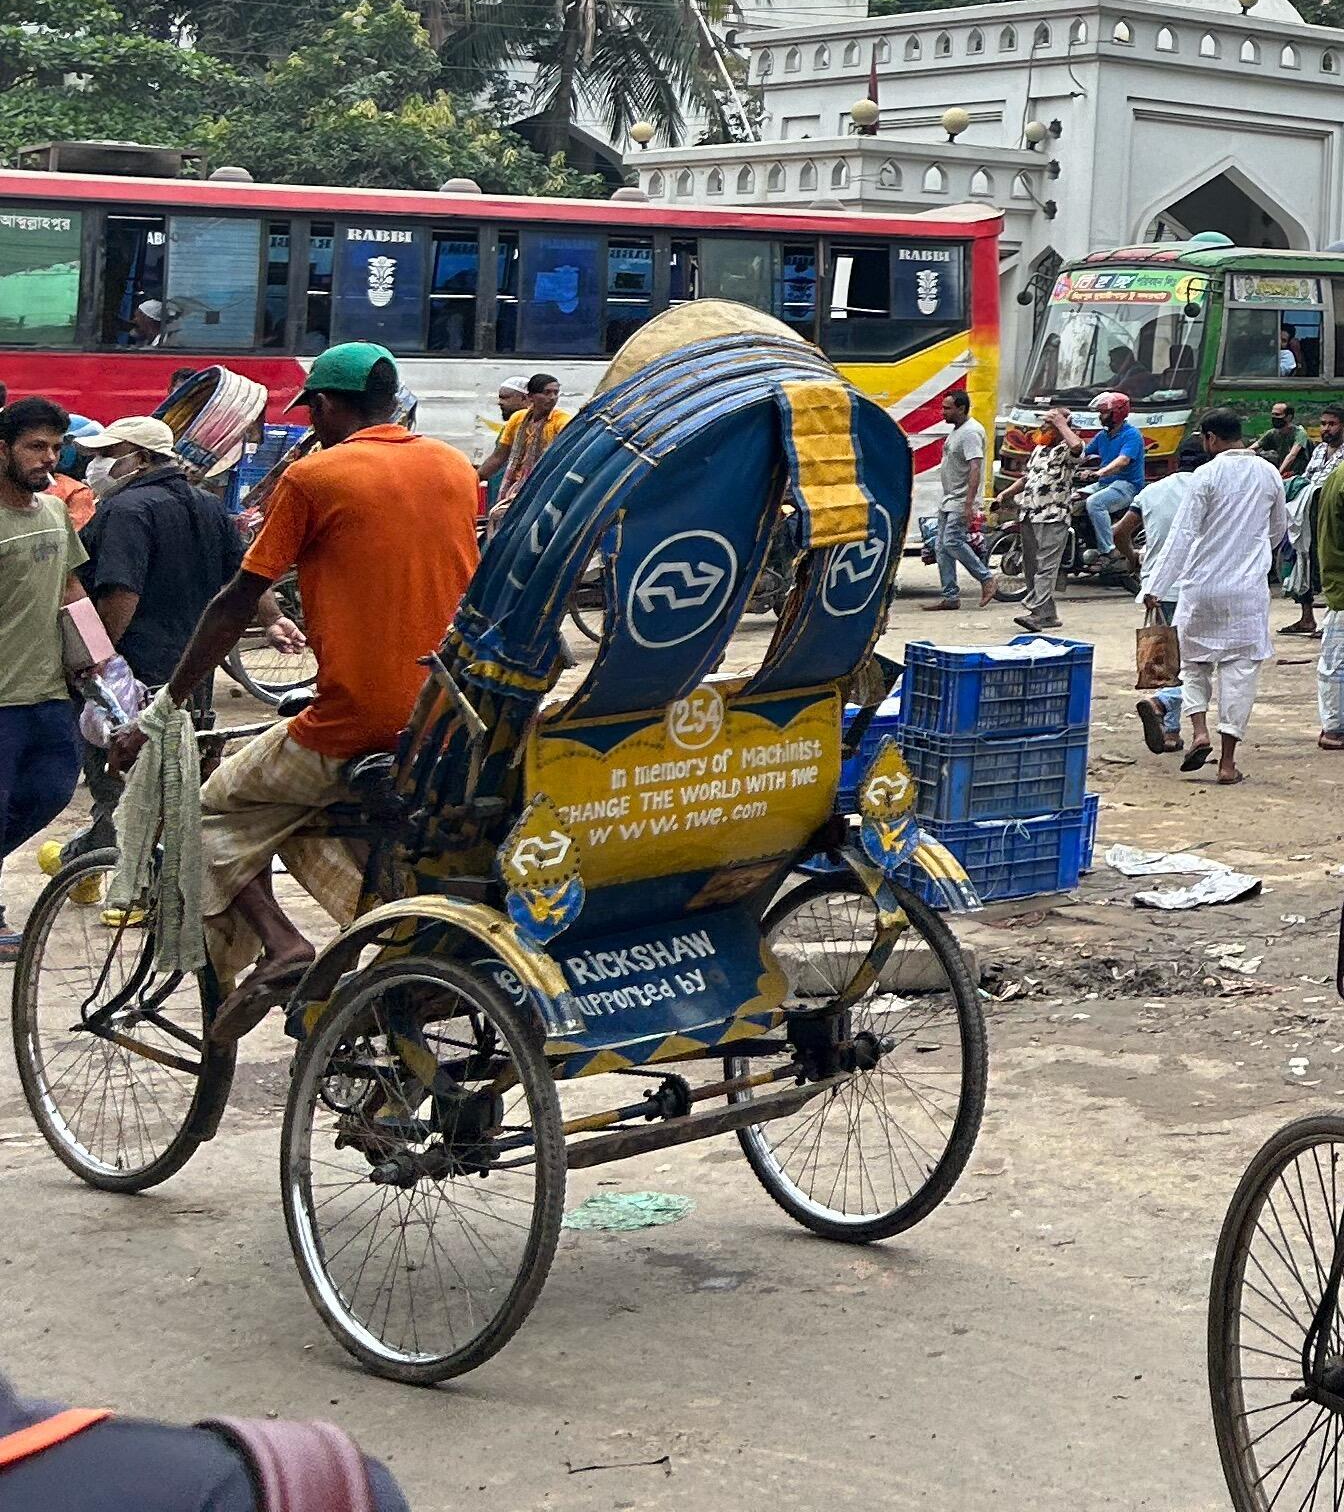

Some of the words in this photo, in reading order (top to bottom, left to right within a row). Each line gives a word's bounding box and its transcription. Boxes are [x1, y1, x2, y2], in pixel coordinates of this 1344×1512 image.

[347, 228, 413, 244] RABBI
[899, 248, 951, 262] RABBI
[676, 696, 723, 734] 254
[634, 755, 706, 785] memory
[712, 749, 732, 773] of
[640, 788, 674, 812] THE
[679, 776, 741, 806] WORLD
[746, 771, 786, 795] WITH
[574, 977, 676, 1016] upported
[674, 967, 706, 994] by
